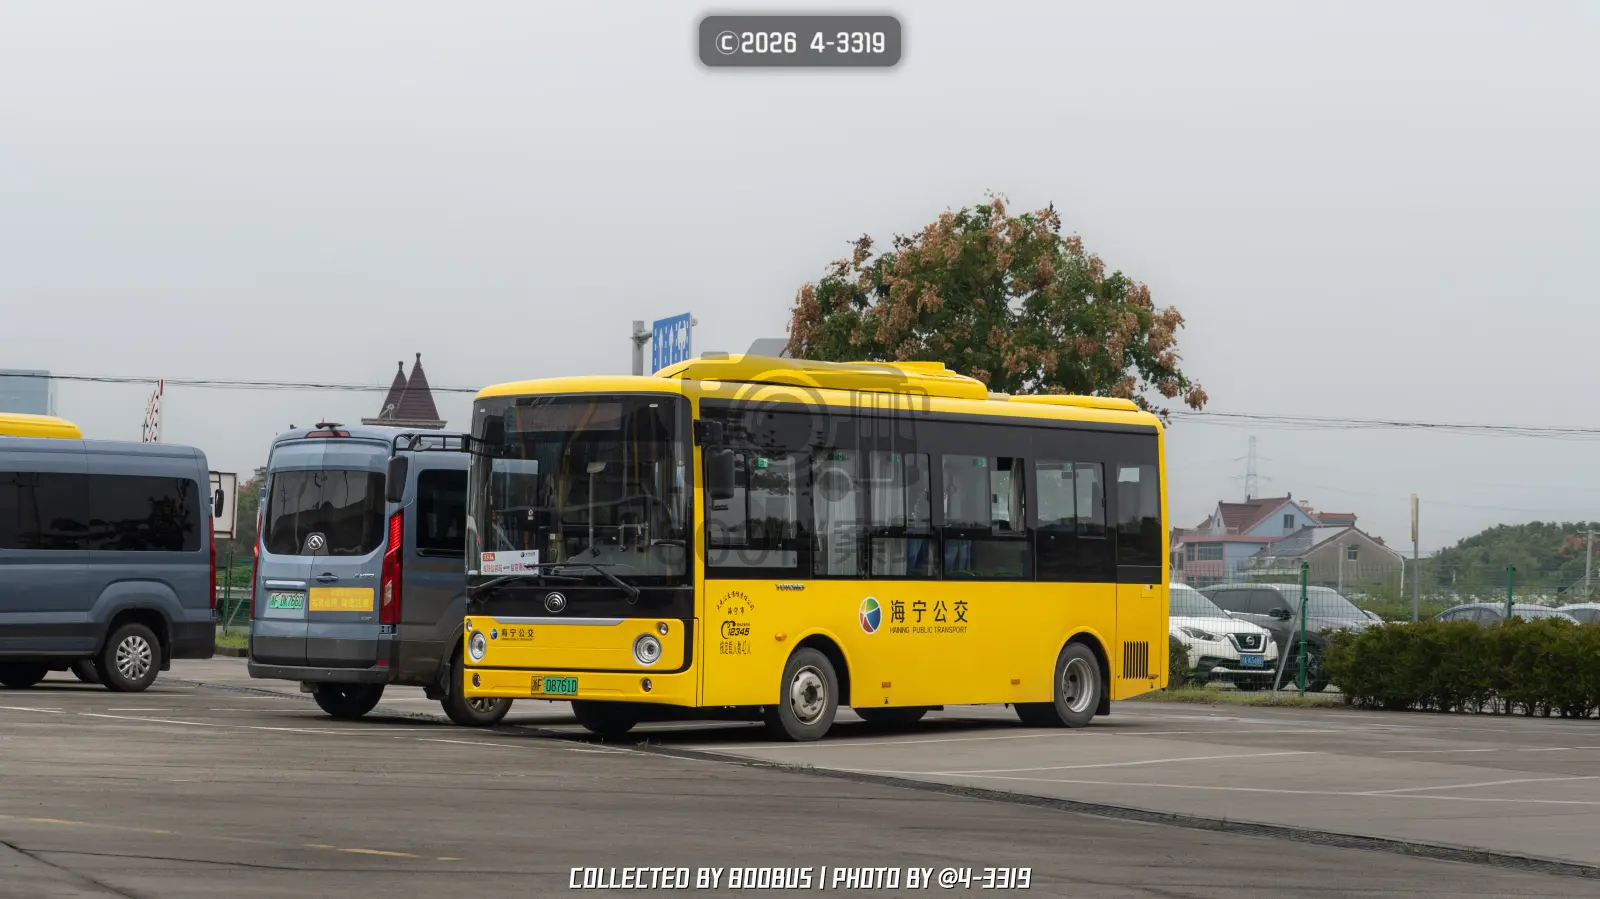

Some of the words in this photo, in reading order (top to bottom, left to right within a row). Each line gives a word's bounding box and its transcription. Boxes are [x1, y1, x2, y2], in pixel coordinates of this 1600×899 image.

[890, 599, 969, 623] 海宁公交
[728, 627, 750, 636] 12345
[889, 626, 910, 634] HAINING
[912, 626, 933, 634] PUBLIC
[934, 626, 968, 634] TRANSPORT
